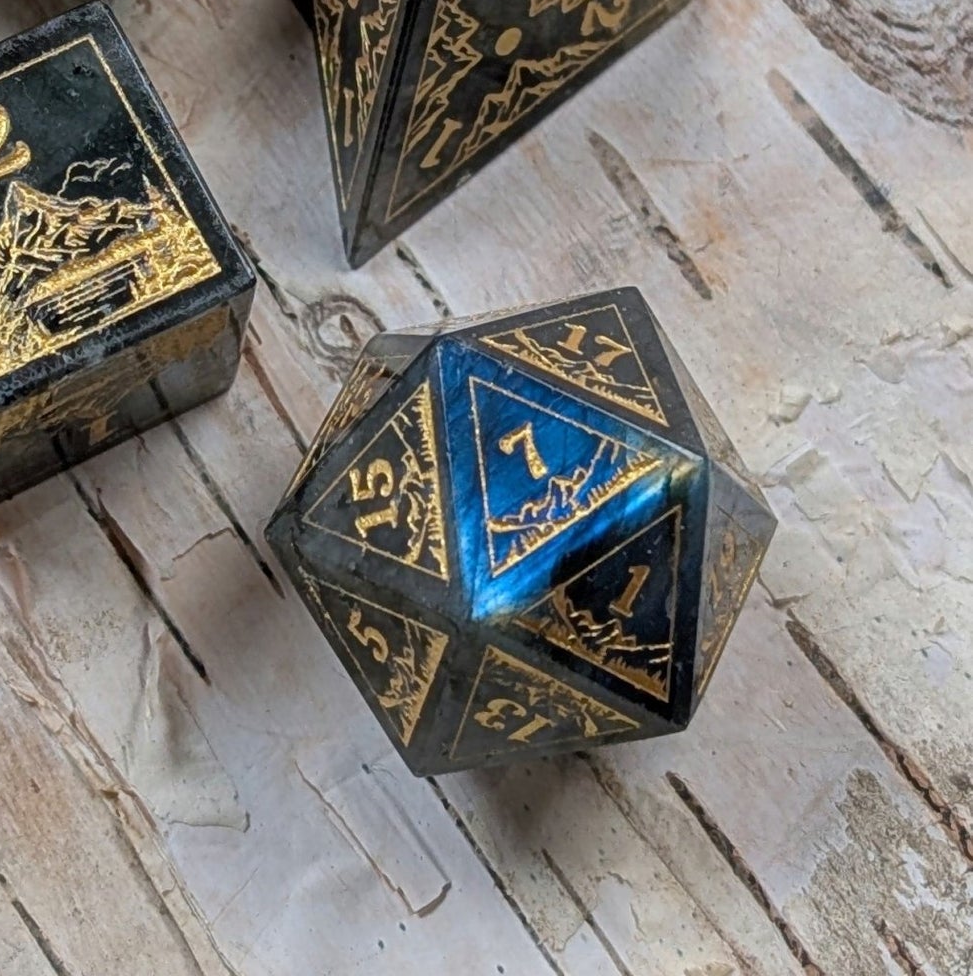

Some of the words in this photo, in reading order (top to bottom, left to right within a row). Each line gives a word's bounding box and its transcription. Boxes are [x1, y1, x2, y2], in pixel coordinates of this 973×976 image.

[343, 87, 354, 148] 1
[420, 118, 463, 169] 1
[556, 323, 632, 367] 17
[498, 423, 548, 478] 7
[349, 458, 399, 539] 15
[610, 565, 650, 617] 1
[348, 608, 388, 663] 5
[473, 698, 552, 743] 13
